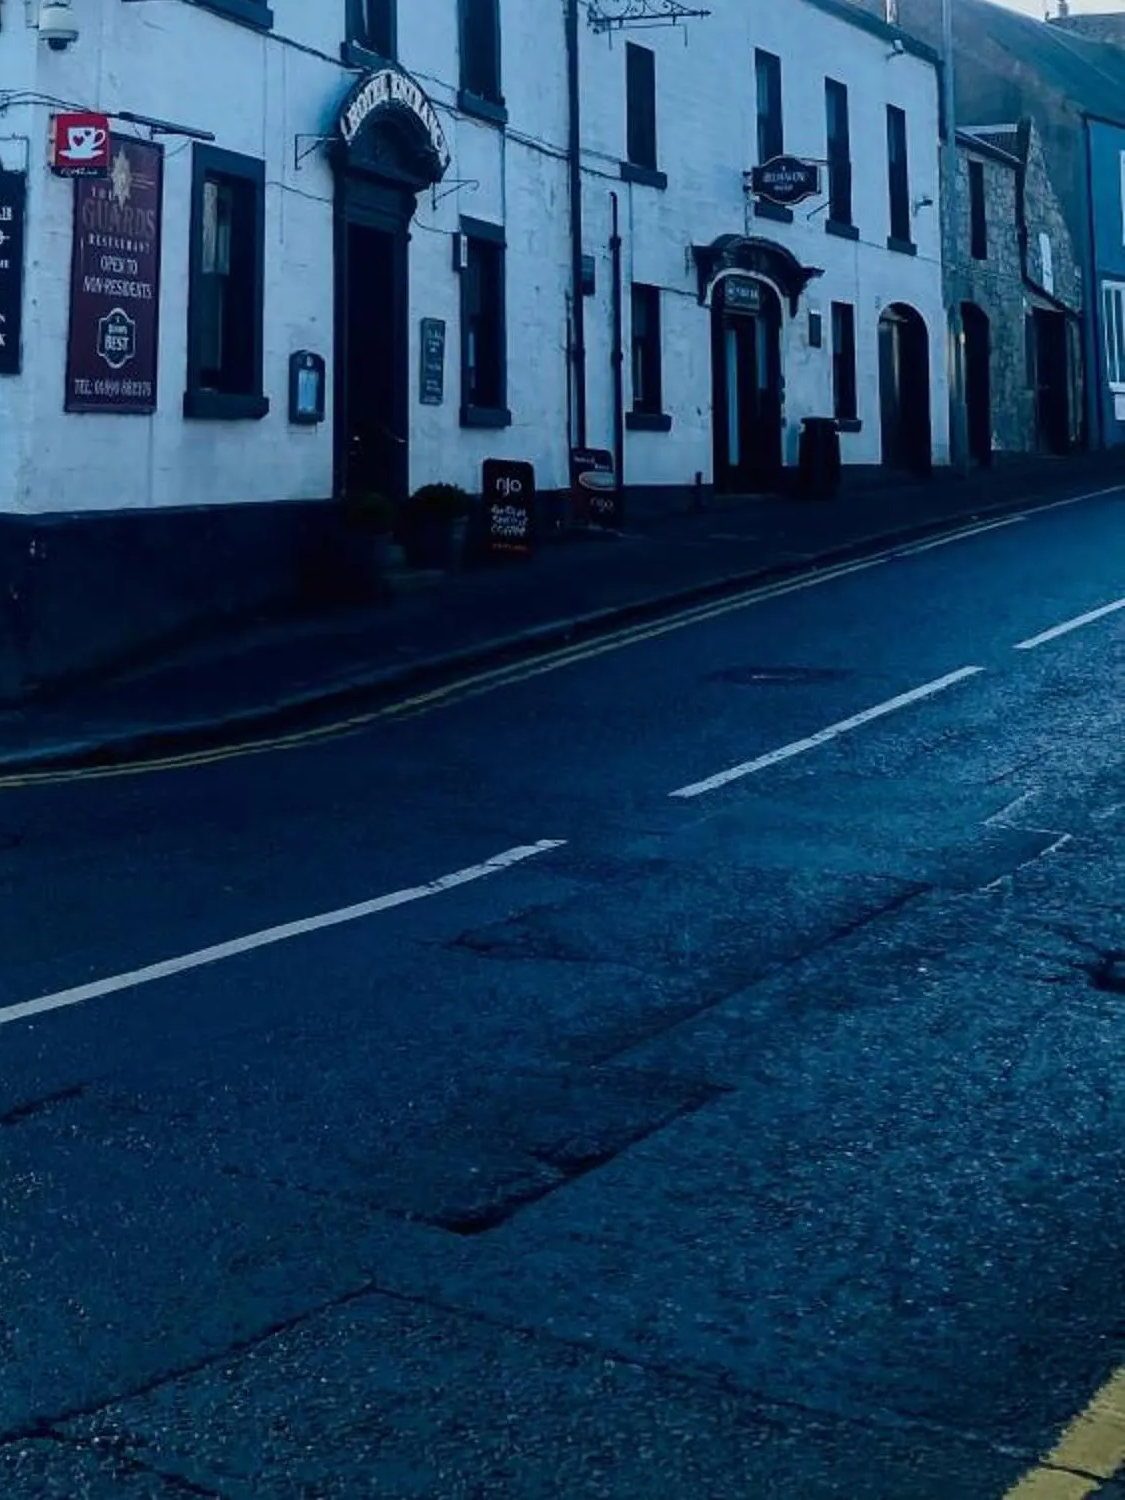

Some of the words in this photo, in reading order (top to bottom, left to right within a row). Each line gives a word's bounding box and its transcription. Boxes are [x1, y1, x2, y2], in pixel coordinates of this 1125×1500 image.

[100, 255, 124, 274] OPEN
[126, 259, 138, 275] TO
[104, 333, 130, 351] BEST
